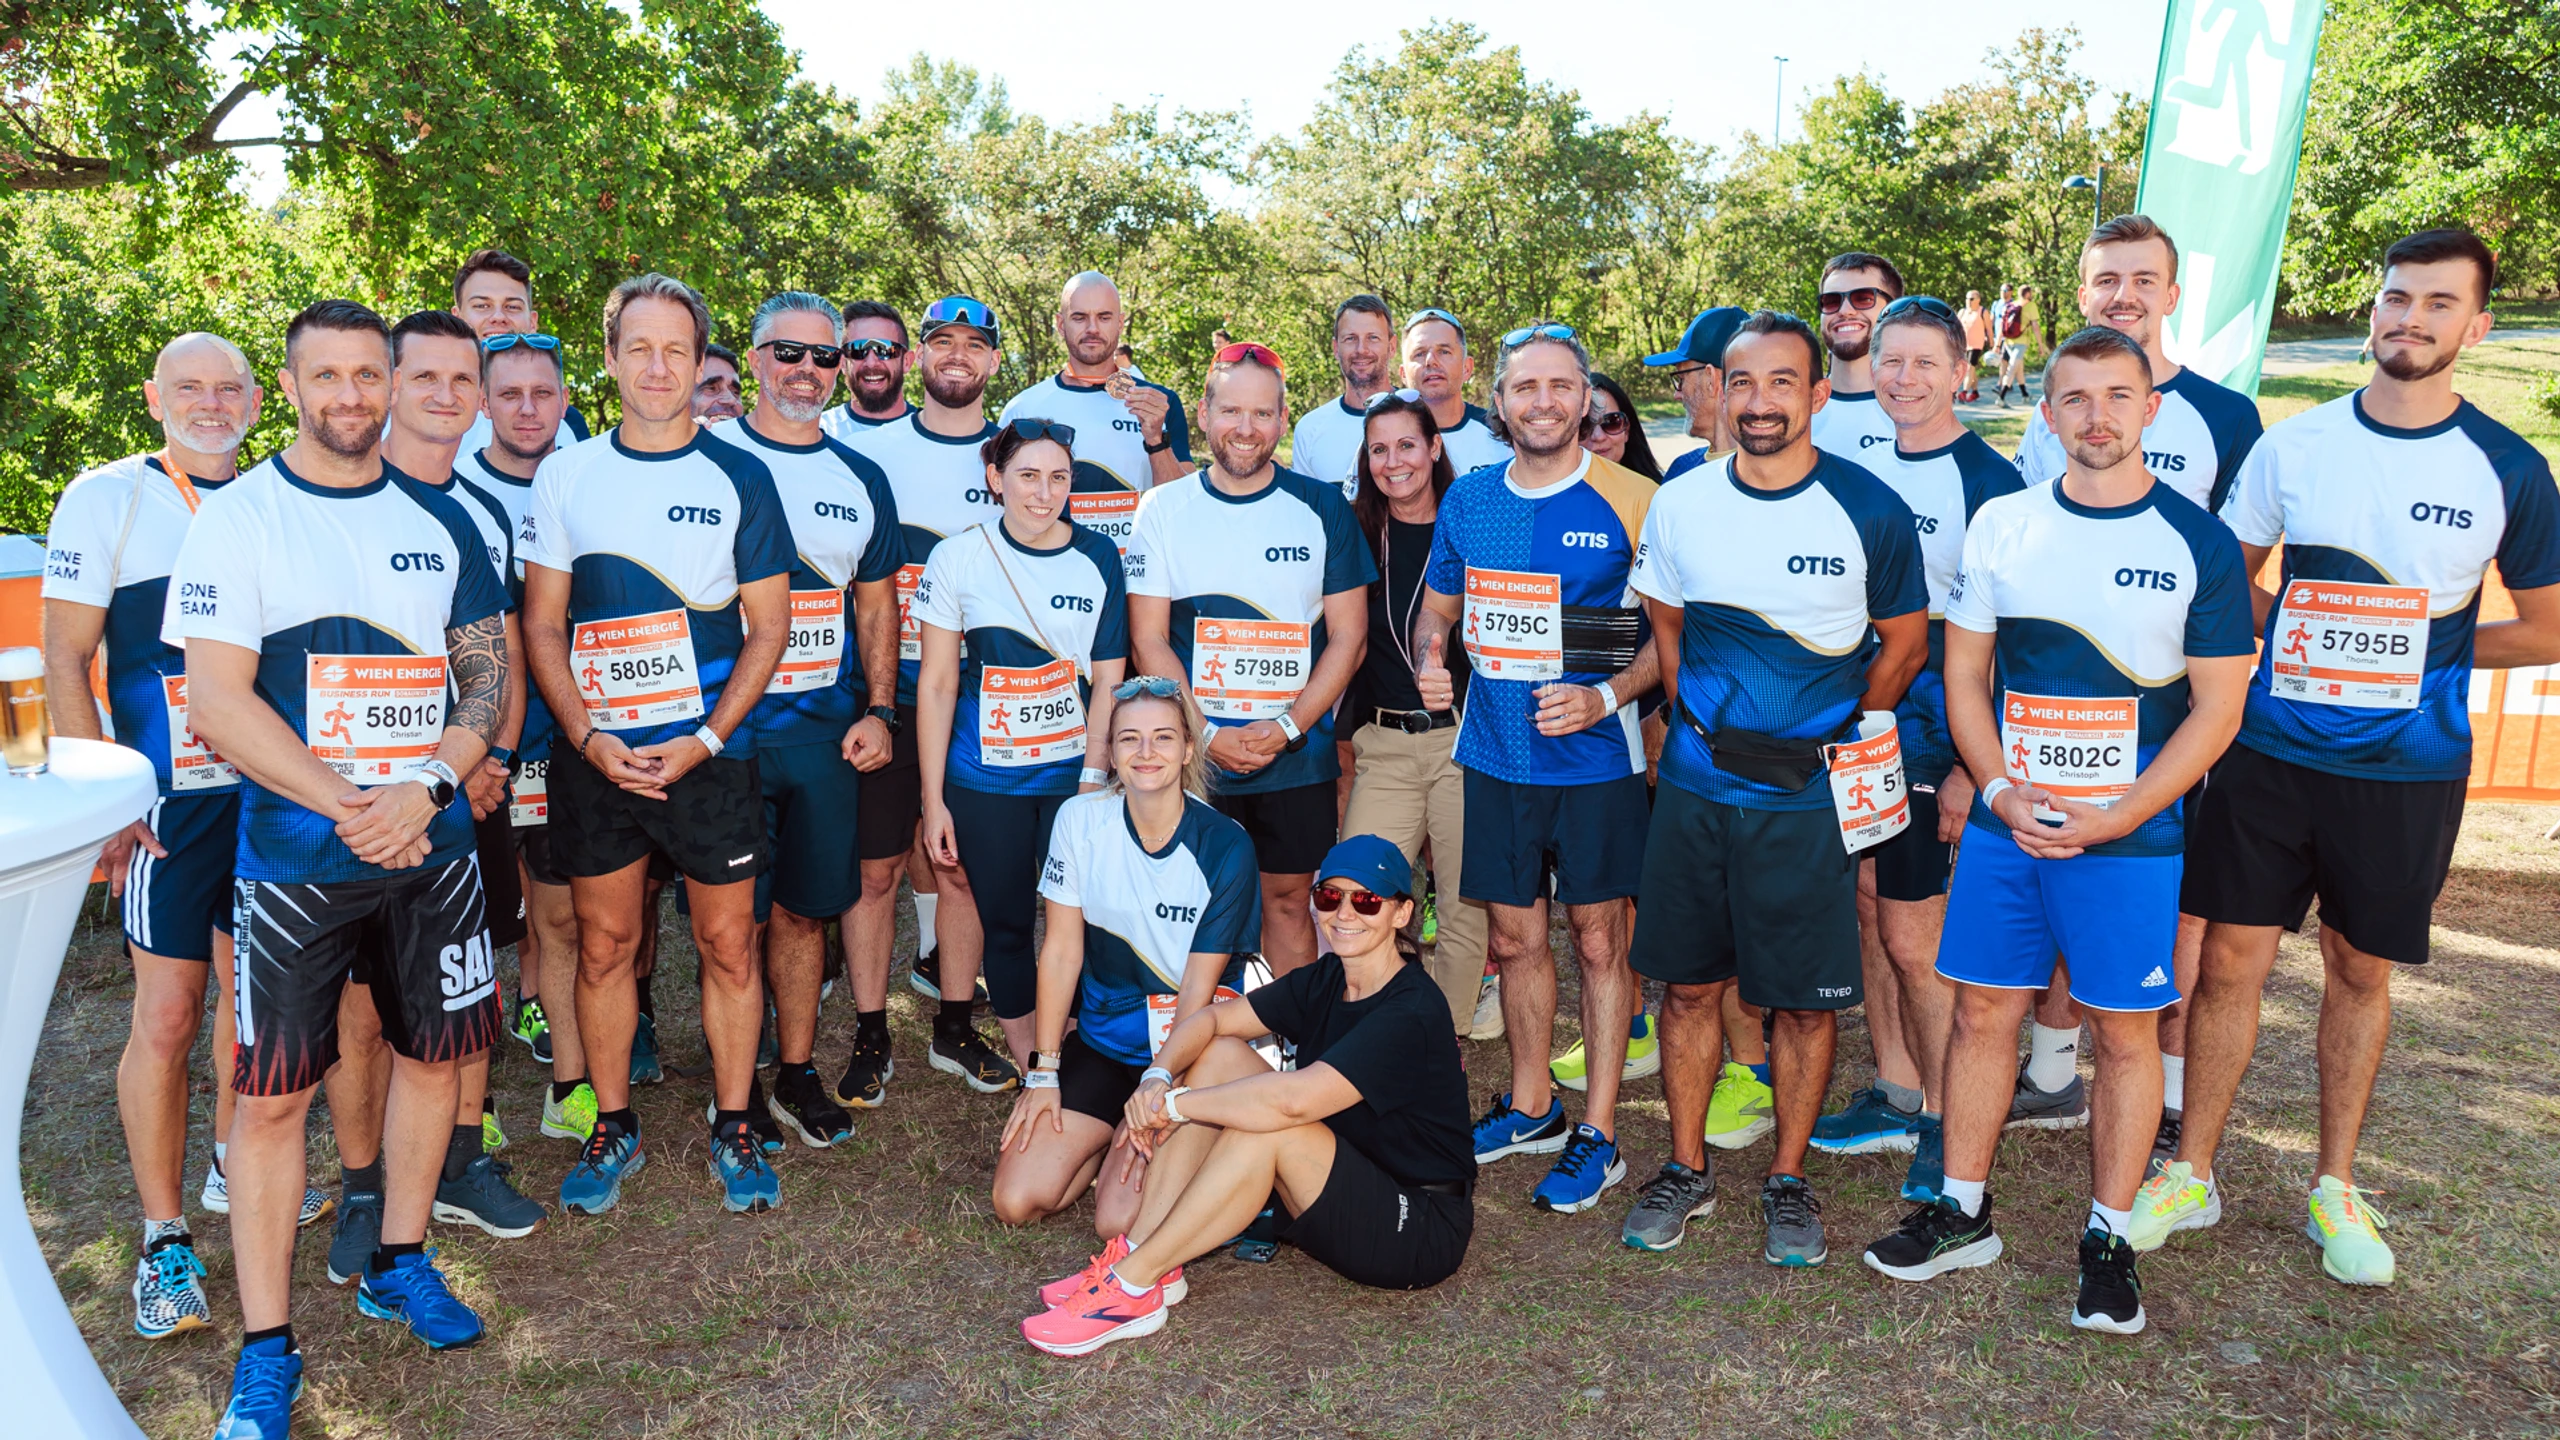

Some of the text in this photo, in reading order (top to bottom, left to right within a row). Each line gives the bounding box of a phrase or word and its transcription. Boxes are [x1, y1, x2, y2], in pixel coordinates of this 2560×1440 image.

[1098, 498, 1134, 508] ENERGIE
[667, 505, 721, 526] OTIS
[814, 501, 859, 523] OTIS
[2410, 501, 2473, 530] OTIS
[1082, 522, 1132, 537] 799C
[1562, 531, 1609, 549] OTIS
[390, 552, 445, 573] OTIS
[1265, 546, 1311, 562] OTIS
[1787, 555, 1846, 576] OTIS
[1480, 579, 1552, 595] WIEN ENERGIE
[2114, 568, 2177, 592] OTIS
[180, 600, 217, 617] TEAM
[798, 598, 837, 609] ENERGIE
[1050, 594, 1094, 613] OTIS
[2317, 592, 2420, 610] WIEN ENERGIE
[1485, 612, 1549, 635] 5795C
[2287, 611, 2326, 621] BUSINESS
[2328, 614, 2348, 622] RUN
[597, 621, 680, 641] WIEN ENERGIE
[1227, 628, 1304, 641] WIEN ENERGIE
[2322, 629, 2410, 656] 5795B
[610, 654, 684, 681] 5805A
[1234, 658, 1300, 678] 5798B
[2345, 655, 2379, 665] Thomas
[354, 667, 442, 679] WIEN ENERGIE
[636, 680, 661, 688] Roman
[1009, 677, 1038, 687] WIEN
[1256, 678, 1276, 687] Georg
[320, 690, 368, 698] BUSINESS
[987, 693, 1020, 701] BUSINESS
[366, 704, 437, 728] 5801C
[1020, 697, 1075, 723] 5796C
[2029, 707, 2128, 721] WIEN ENERGIE
[390, 731, 422, 739] Christian
[2008, 725, 2040, 736] BUSINESS
[1865, 740, 1897, 758] WIEN
[2039, 745, 2121, 768] 5802C
[1840, 763, 1881, 778] BUSINESS
[2059, 770, 2100, 779] Christoph
[1155, 902, 1197, 924] OTIS
[241, 915, 250, 954] COMBAT
